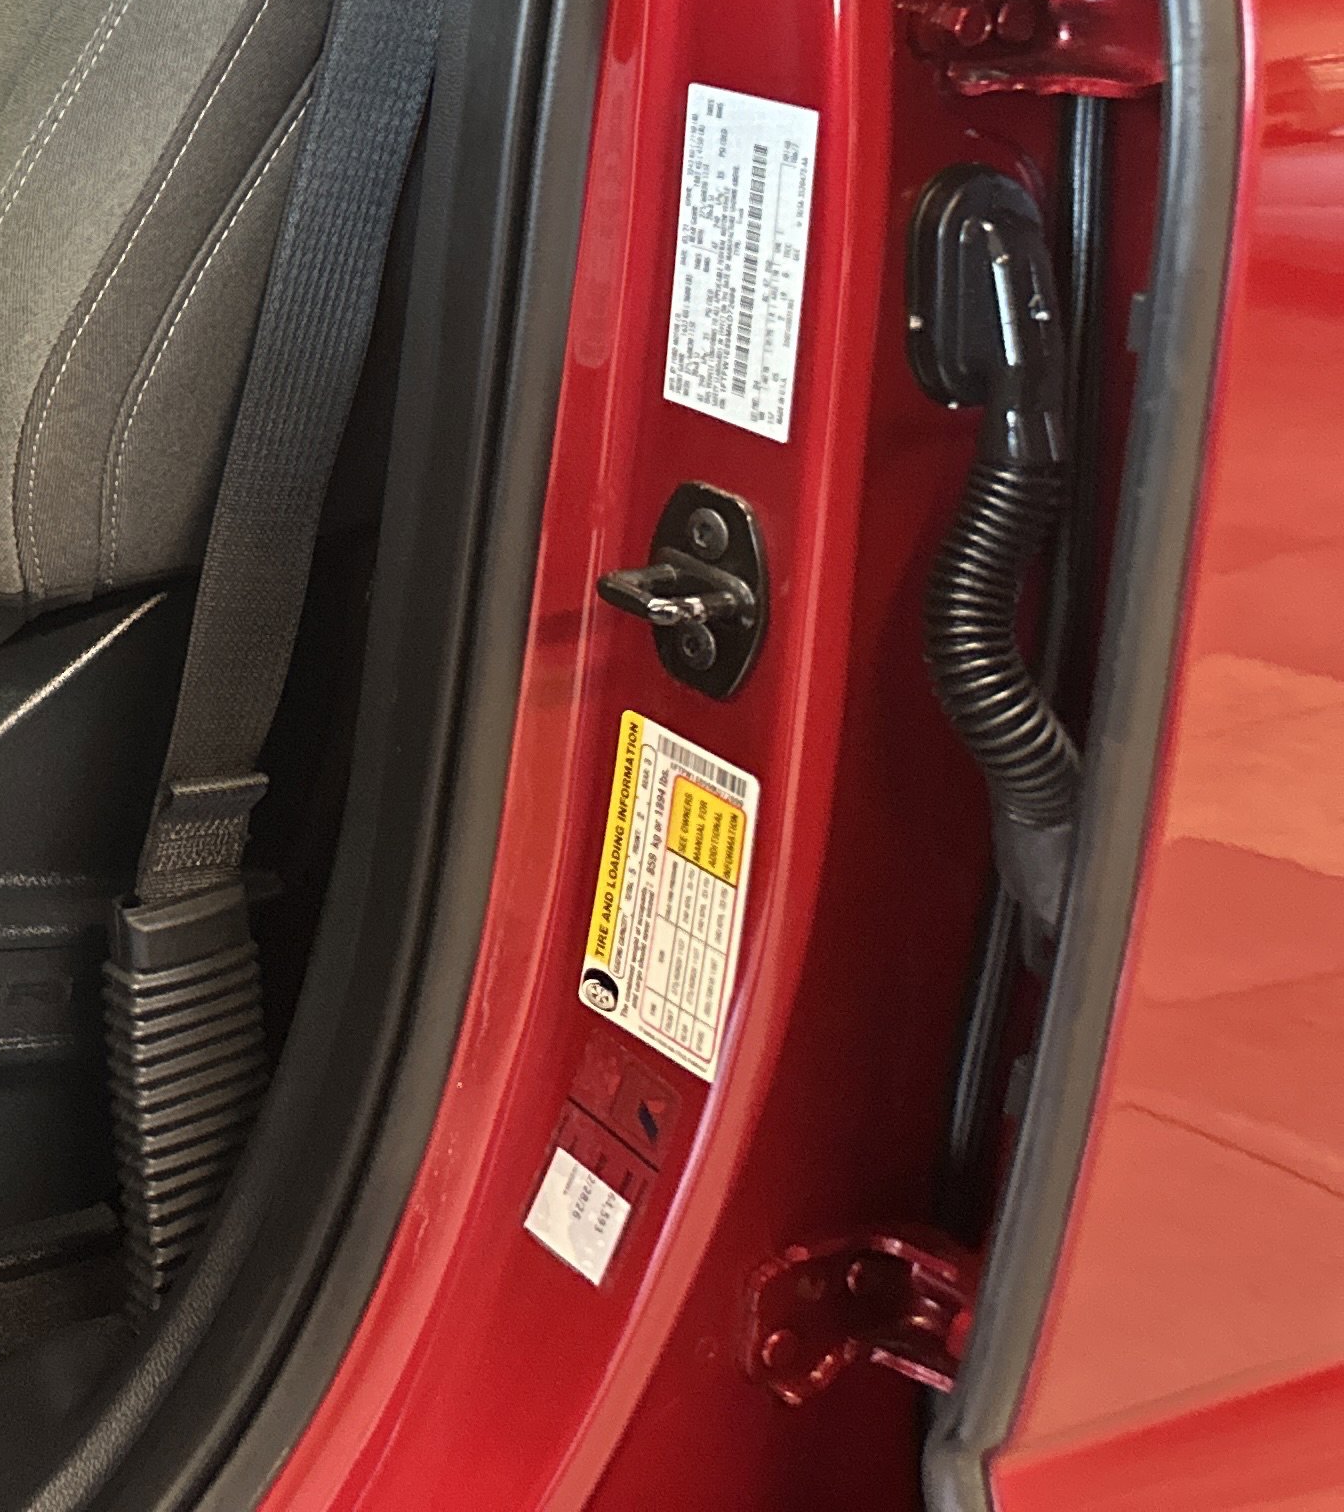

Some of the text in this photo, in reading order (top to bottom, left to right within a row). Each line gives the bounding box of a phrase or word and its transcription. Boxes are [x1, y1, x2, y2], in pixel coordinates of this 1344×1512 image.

[595, 722, 638, 956] TIRE AND LOADING INFORMATION
[650, 834, 662, 849] kg
[654, 819, 661, 832] or
[678, 836, 687, 853] SEE
[693, 800, 707, 862] MANUAL FOR
[709, 813, 722, 868] ADDITIONAL
[724, 813, 738, 879] INFORMATION
